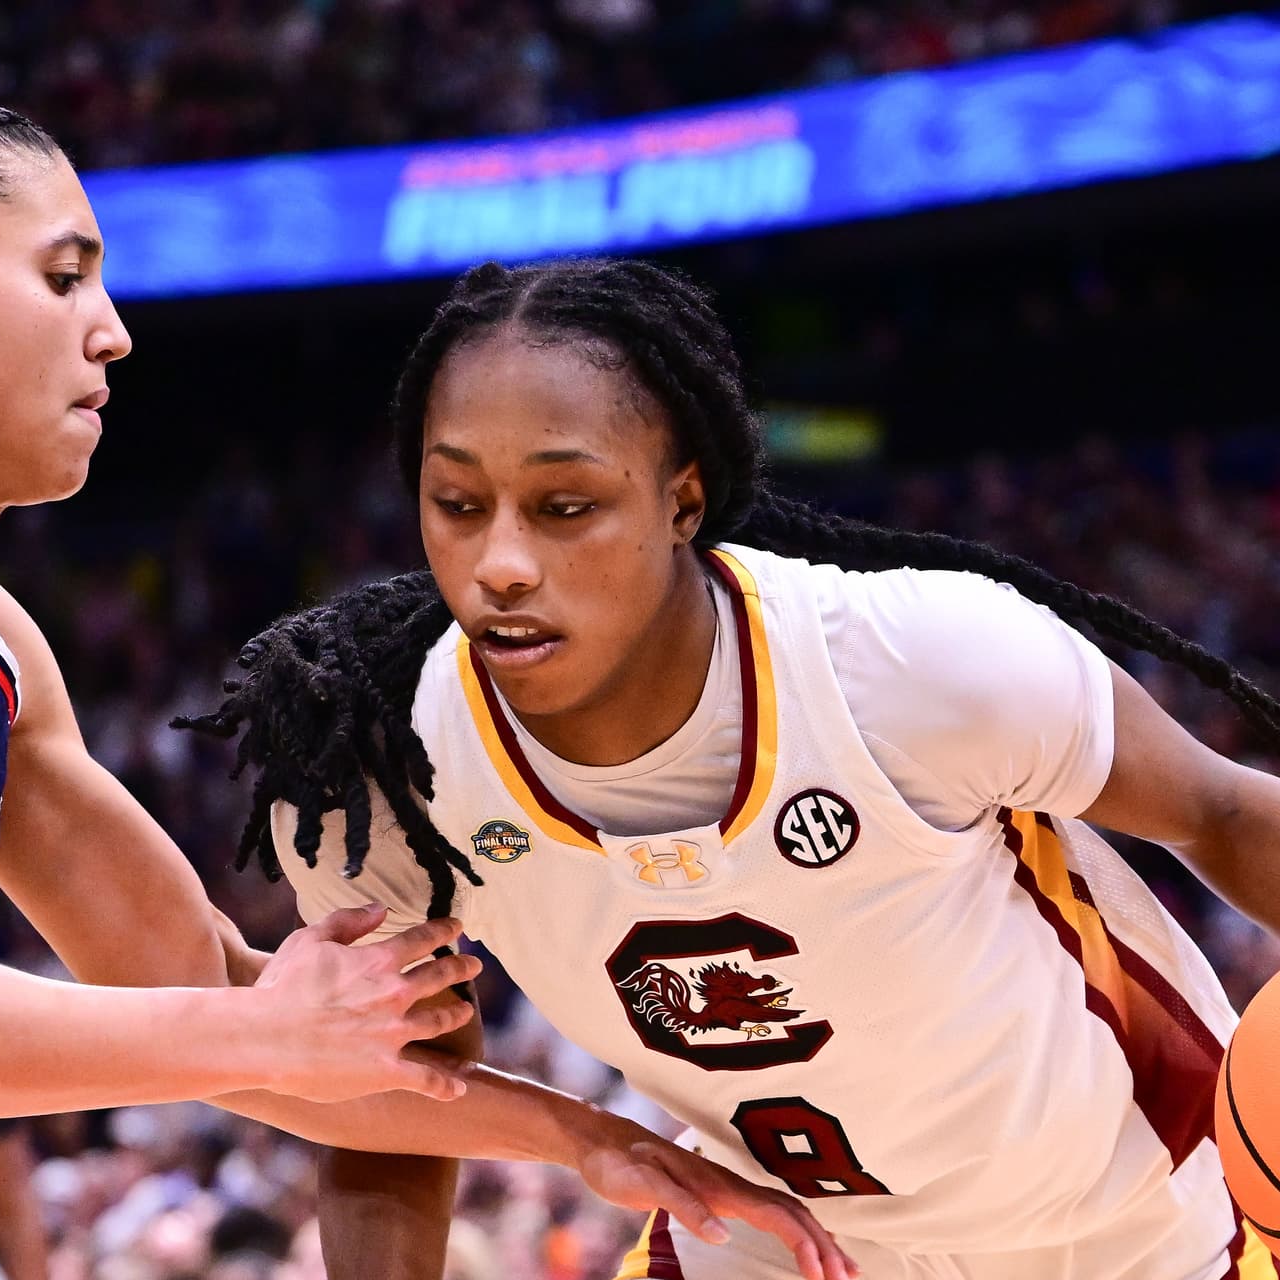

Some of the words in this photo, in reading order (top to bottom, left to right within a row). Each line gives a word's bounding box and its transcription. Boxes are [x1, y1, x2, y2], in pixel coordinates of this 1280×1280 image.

[475, 837, 500, 850] FINAL
[502, 836, 528, 847] FOUR
[781, 794, 852, 863] SEC
[729, 1095, 894, 1199] 8
